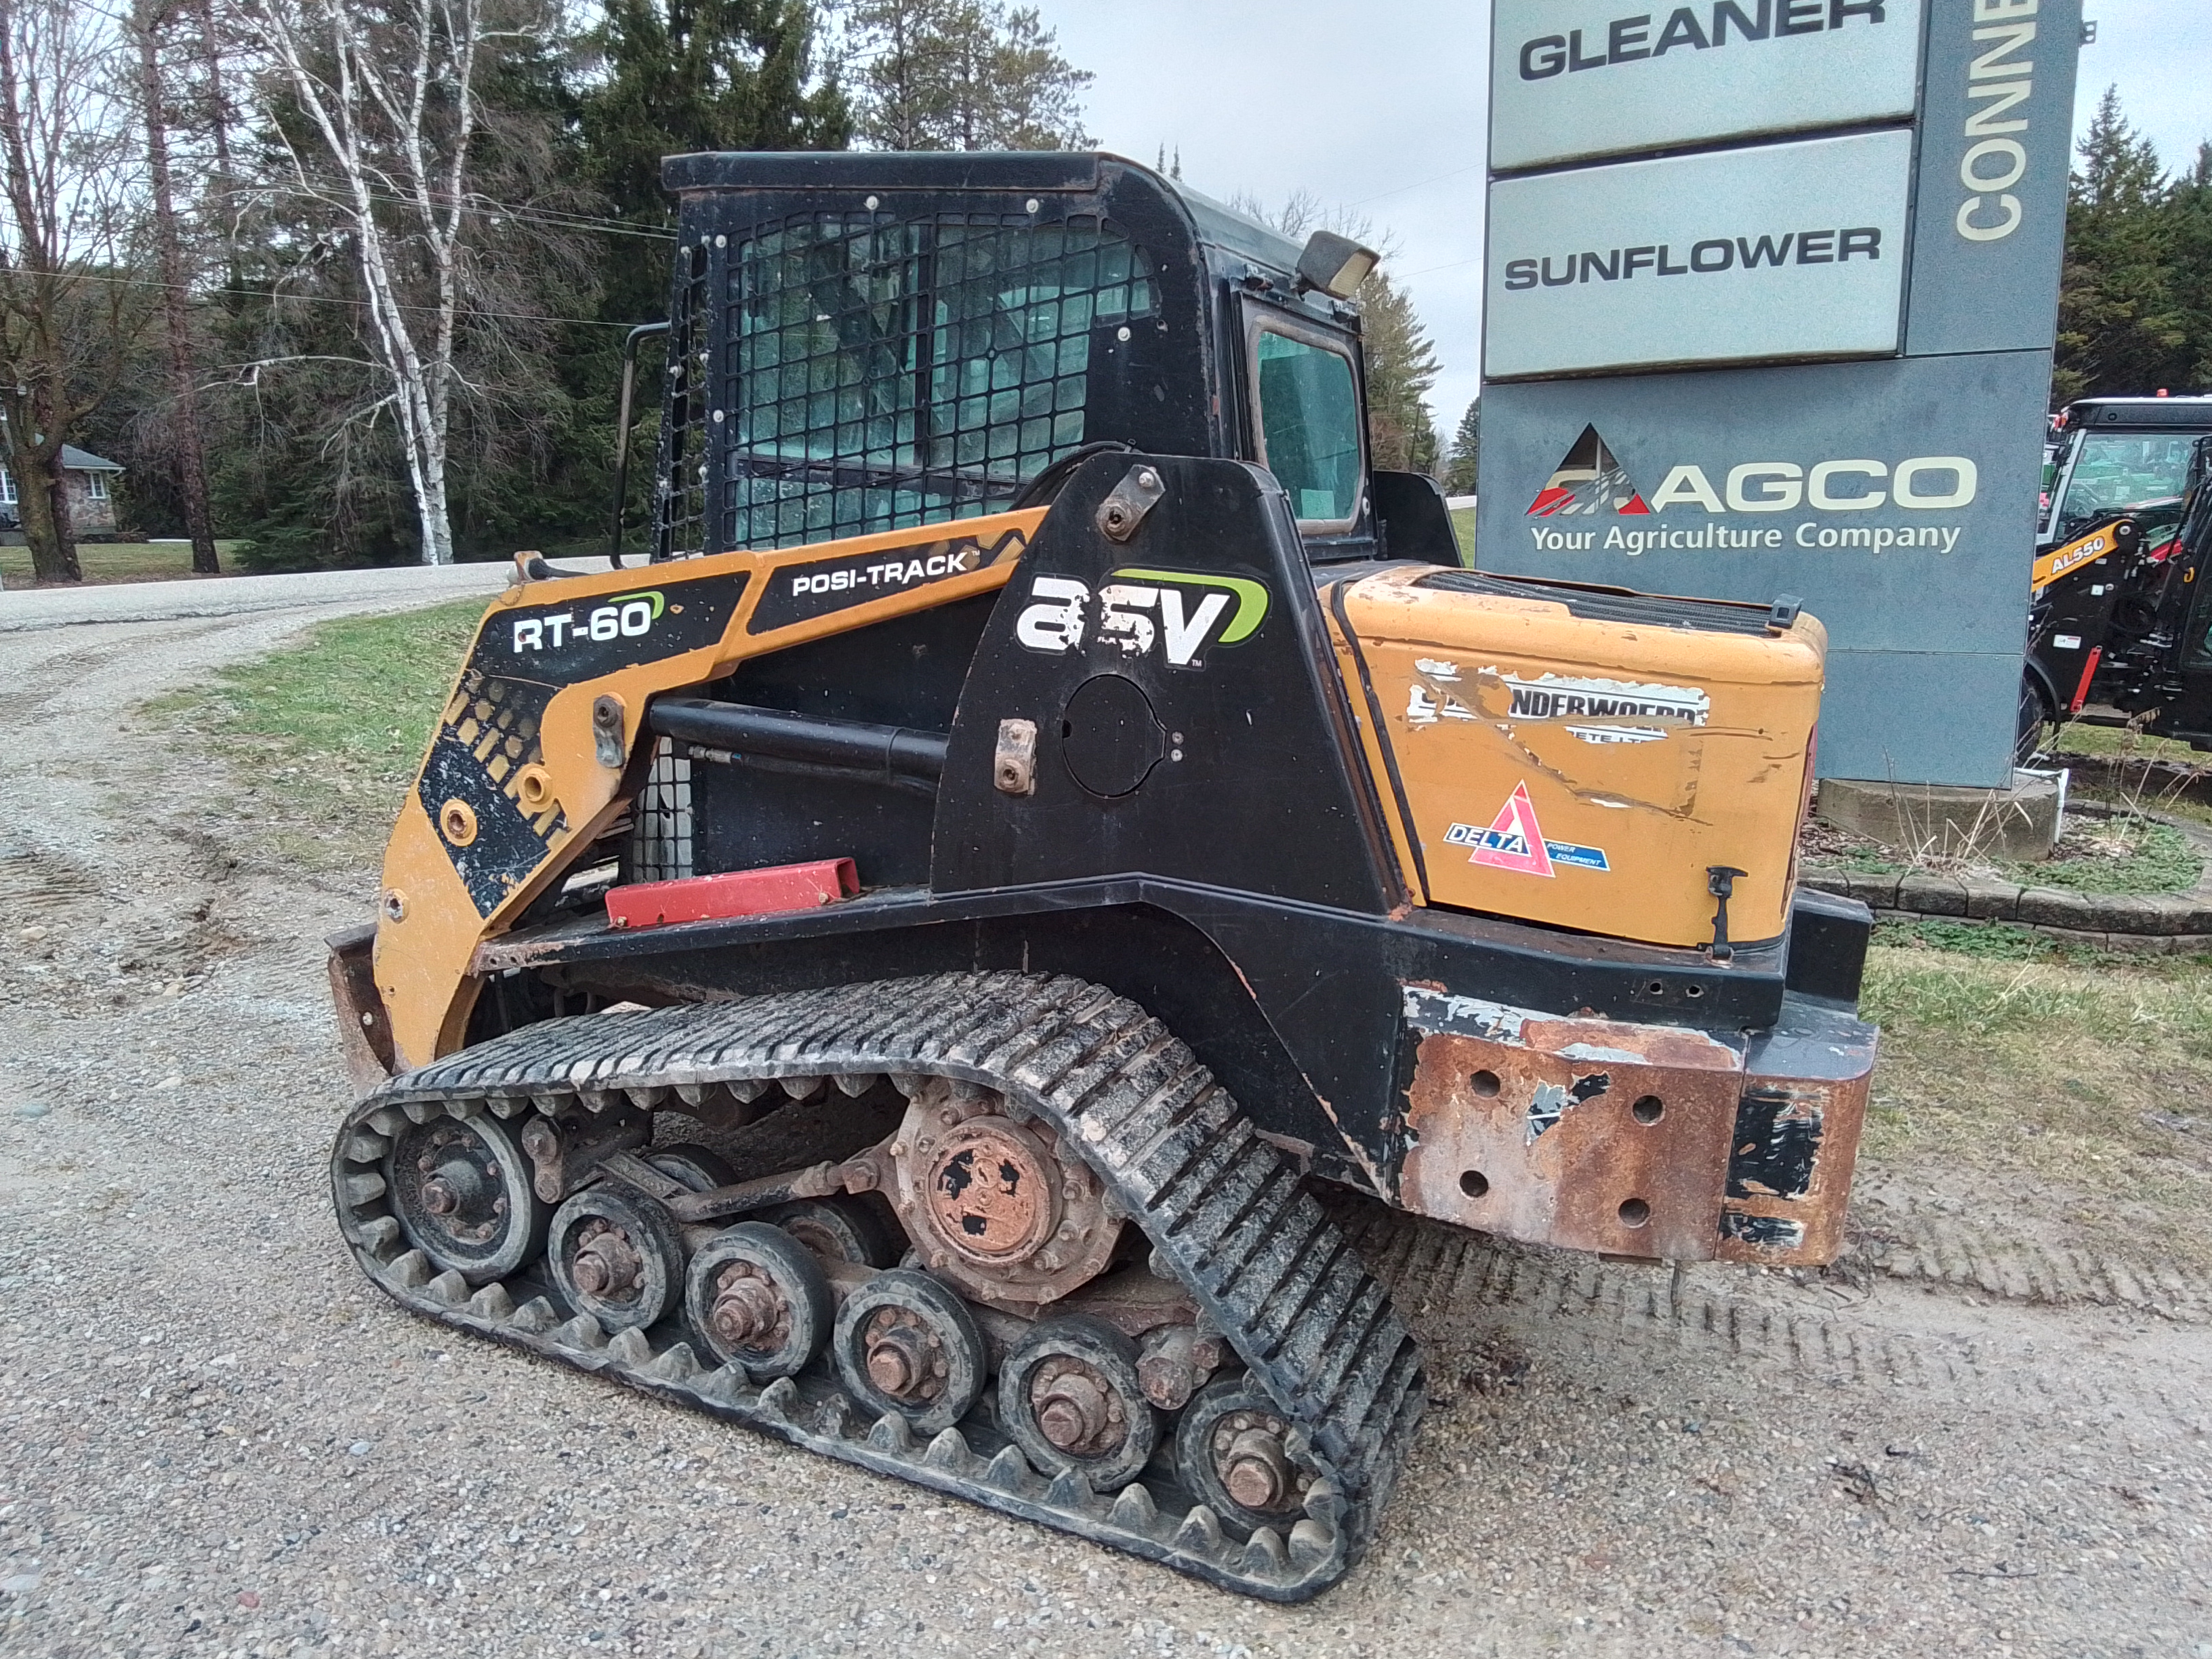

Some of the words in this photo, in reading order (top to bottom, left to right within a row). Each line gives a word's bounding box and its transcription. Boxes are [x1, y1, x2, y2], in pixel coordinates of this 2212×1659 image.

[1519, 0, 1886, 81] GLEANER
[1504, 226, 1882, 291] SUNFLOWER
[1650, 456, 1978, 513] AGCO
[1530, 527, 1596, 550] Your
[1603, 522, 1783, 556] Agriculture
[1795, 522, 1961, 554] Company
[2051, 536, 2105, 574] AL550
[792, 552, 968, 597] POSI-TRACK
[513, 601, 651, 653] RT-60
[1448, 825, 1525, 854] DELTA
[1547, 842, 1576, 854] POWER
[1555, 853, 1602, 866] EQUIPMENT
